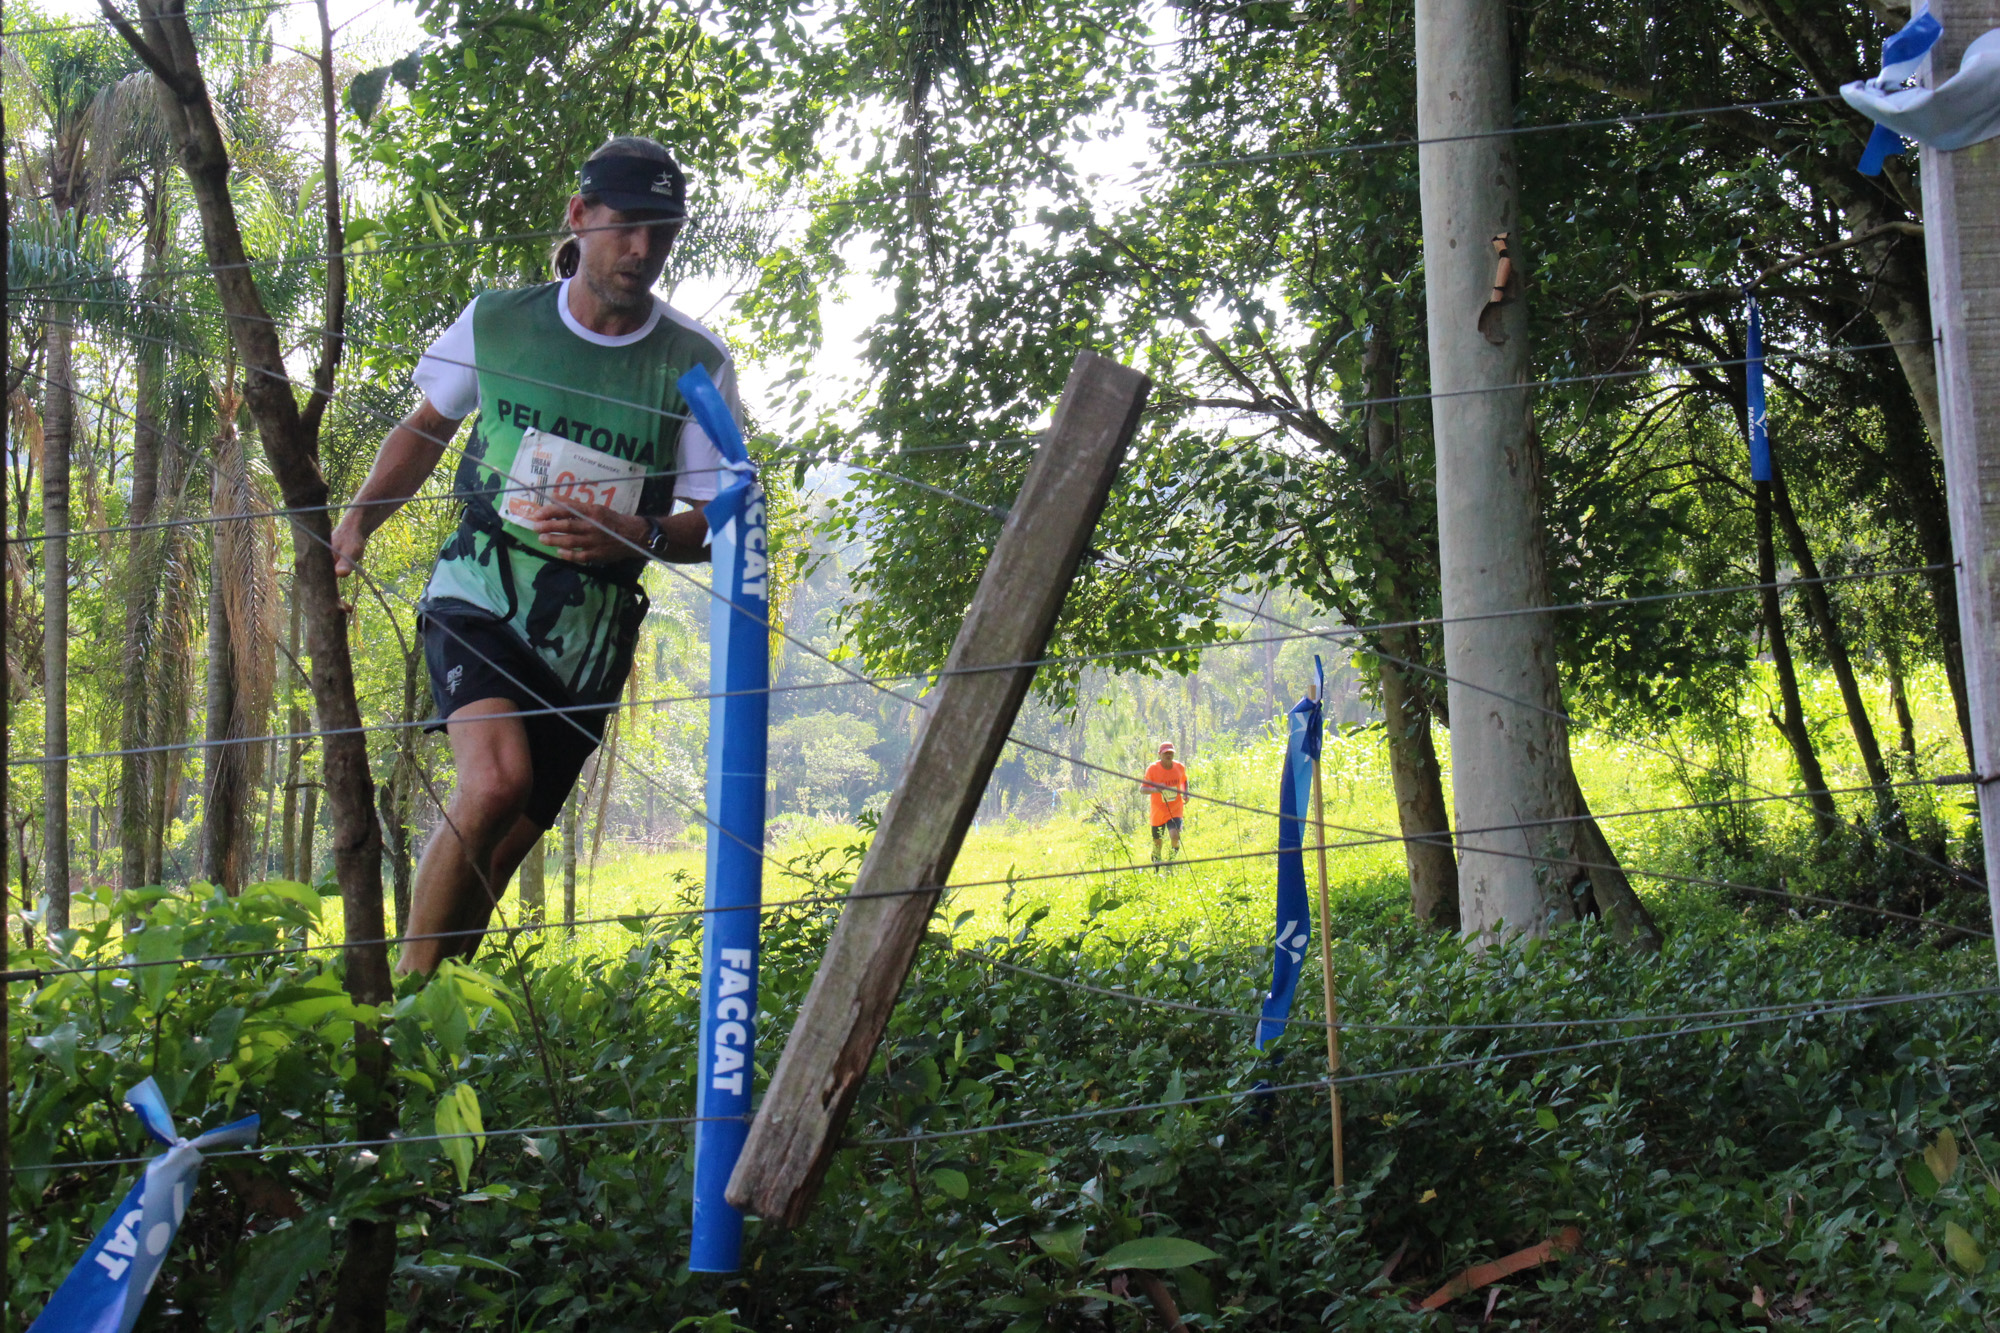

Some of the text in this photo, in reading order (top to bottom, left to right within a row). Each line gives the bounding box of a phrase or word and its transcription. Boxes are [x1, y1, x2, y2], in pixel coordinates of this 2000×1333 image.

[497, 400, 655, 466] PELATONA
[553, 471, 616, 508] 051
[743, 481, 767, 601] ACCAT
[713, 948, 750, 1095] FACCAT
